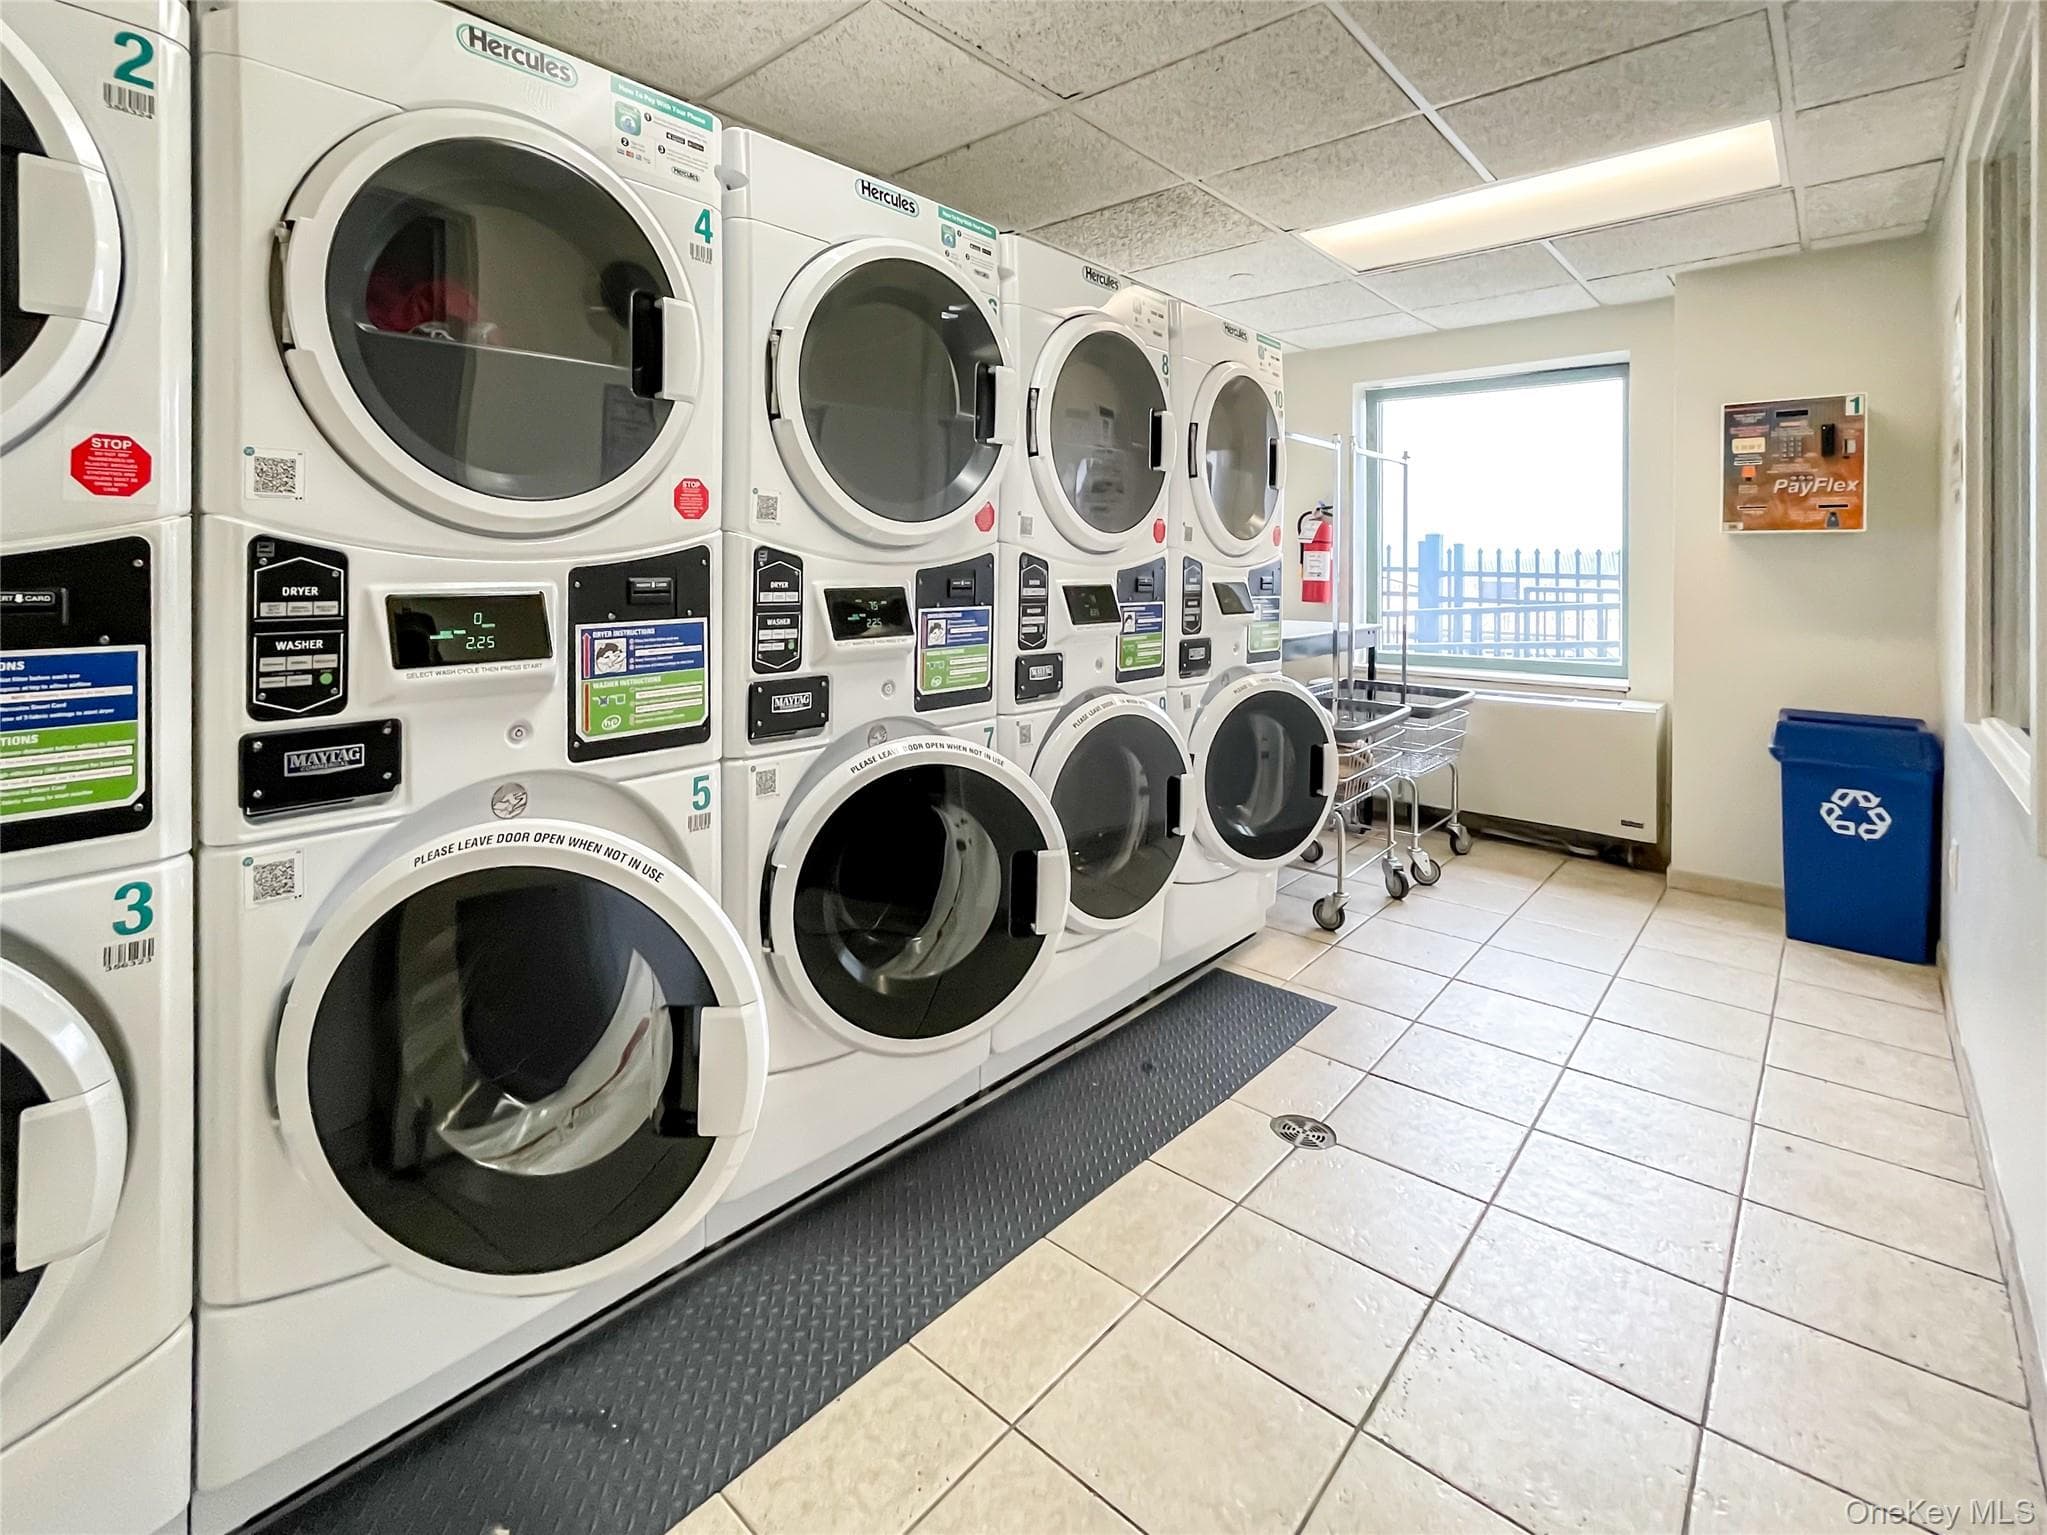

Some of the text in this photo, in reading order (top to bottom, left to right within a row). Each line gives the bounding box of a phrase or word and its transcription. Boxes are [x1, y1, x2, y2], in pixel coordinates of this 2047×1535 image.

[114, 31, 154, 90] 2
[468, 25, 571, 82] Hercules
[861, 178, 916, 214] Hercules
[695, 208, 713, 244] 4
[1085, 266, 1119, 290] Hercules
[1162, 354, 1169, 375] 8
[1849, 396, 1860, 414] 1
[91, 438, 132, 449] STOP
[1772, 477, 1860, 497] PayFlex
[281, 586, 319, 596] DRYER
[766, 618, 791, 626] WASHER
[275, 639, 323, 651] WASHER
[465, 635, 495, 650] 2.25
[406, 671, 433, 679] SELECT
[457, 667, 479, 675] CYCLE
[774, 694, 810, 707] MAYTAG
[984, 727, 994, 749] 7
[289, 748, 361, 768] MAYTAG
[850, 756, 877, 774] PLEASE
[946, 744, 968, 752] WHEN
[968, 747, 982, 757] NOT
[992, 757, 1005, 767] USE
[692, 774, 711, 811] 5
[414, 832, 664, 884] PLEASE LEAVE DOOR OPEN WHEN NOT IN USE
[112, 882, 153, 935] 3
